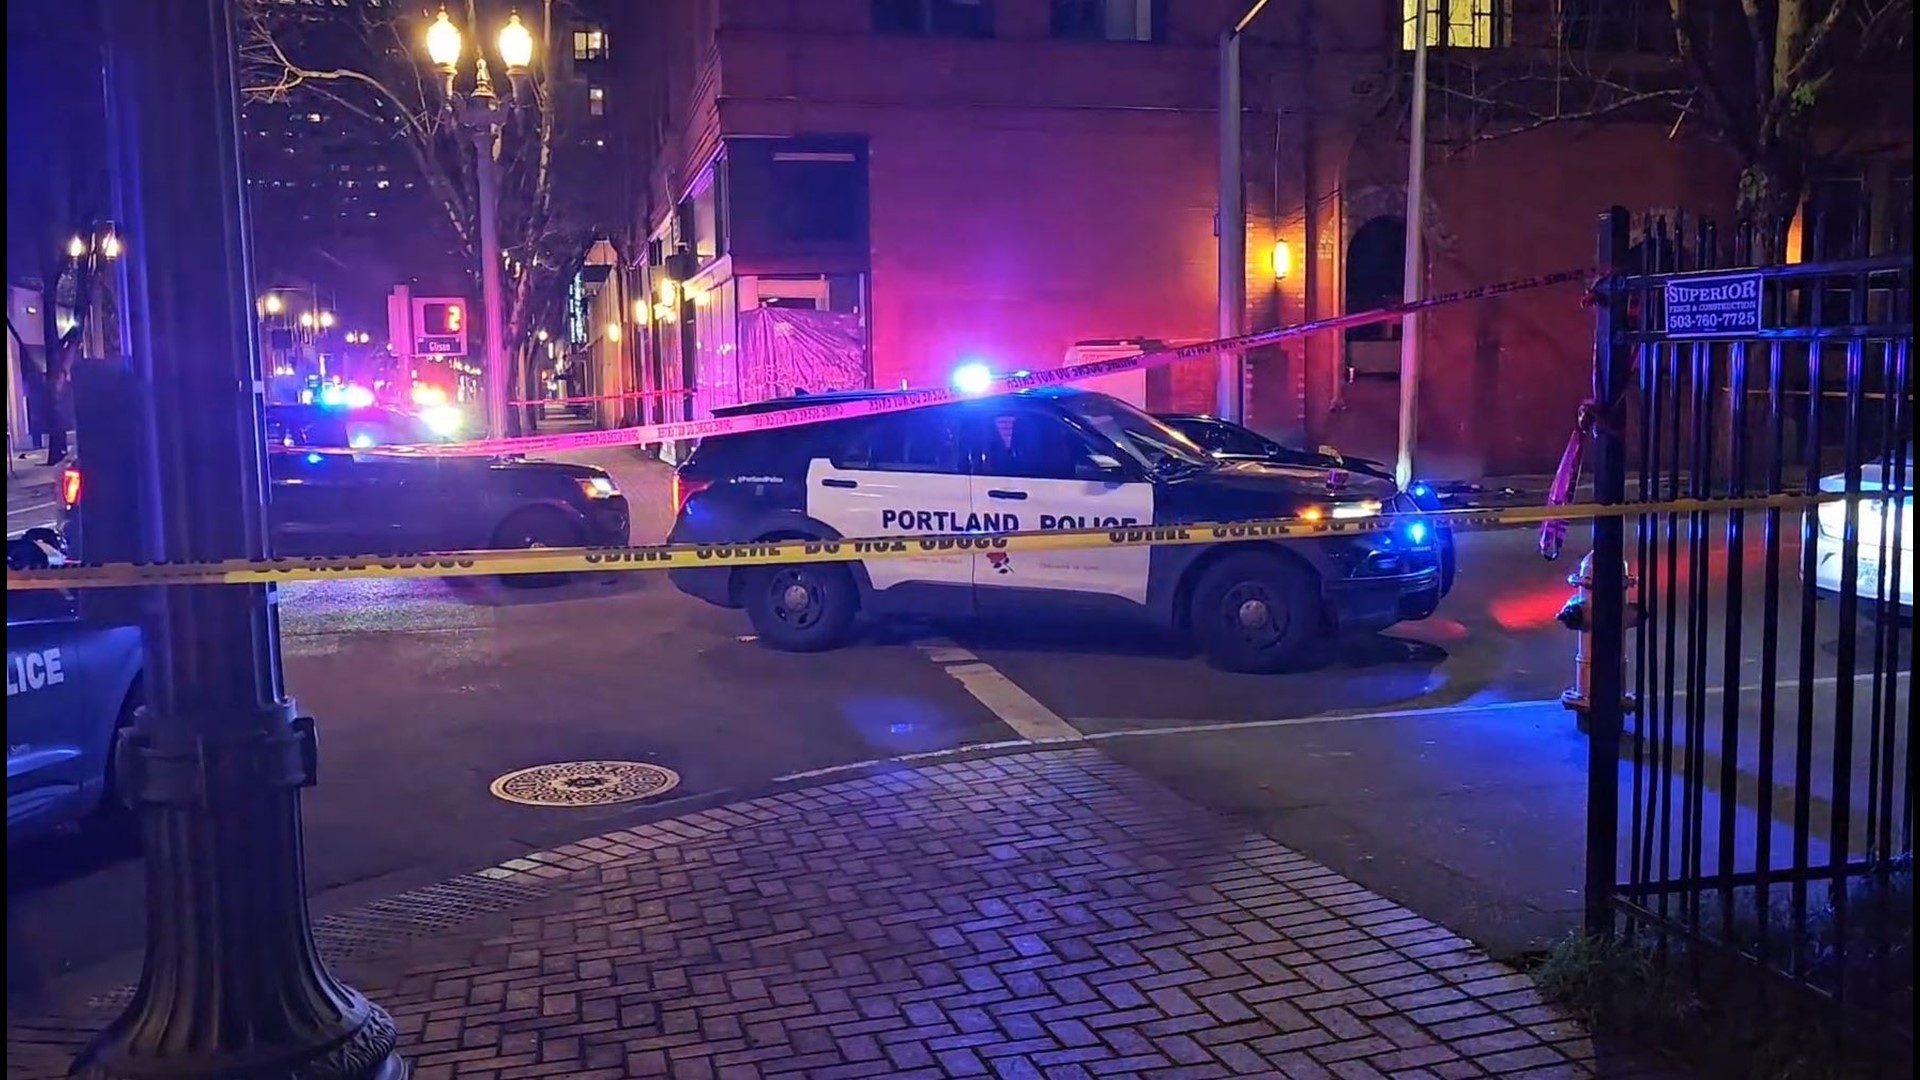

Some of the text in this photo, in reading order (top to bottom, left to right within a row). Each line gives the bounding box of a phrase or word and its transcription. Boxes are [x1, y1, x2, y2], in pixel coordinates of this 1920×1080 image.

[1669, 280, 1756, 303] SUPERIOR
[1670, 311, 1756, 328] 503-760-7725
[882, 509, 1019, 532] PORTLAND
